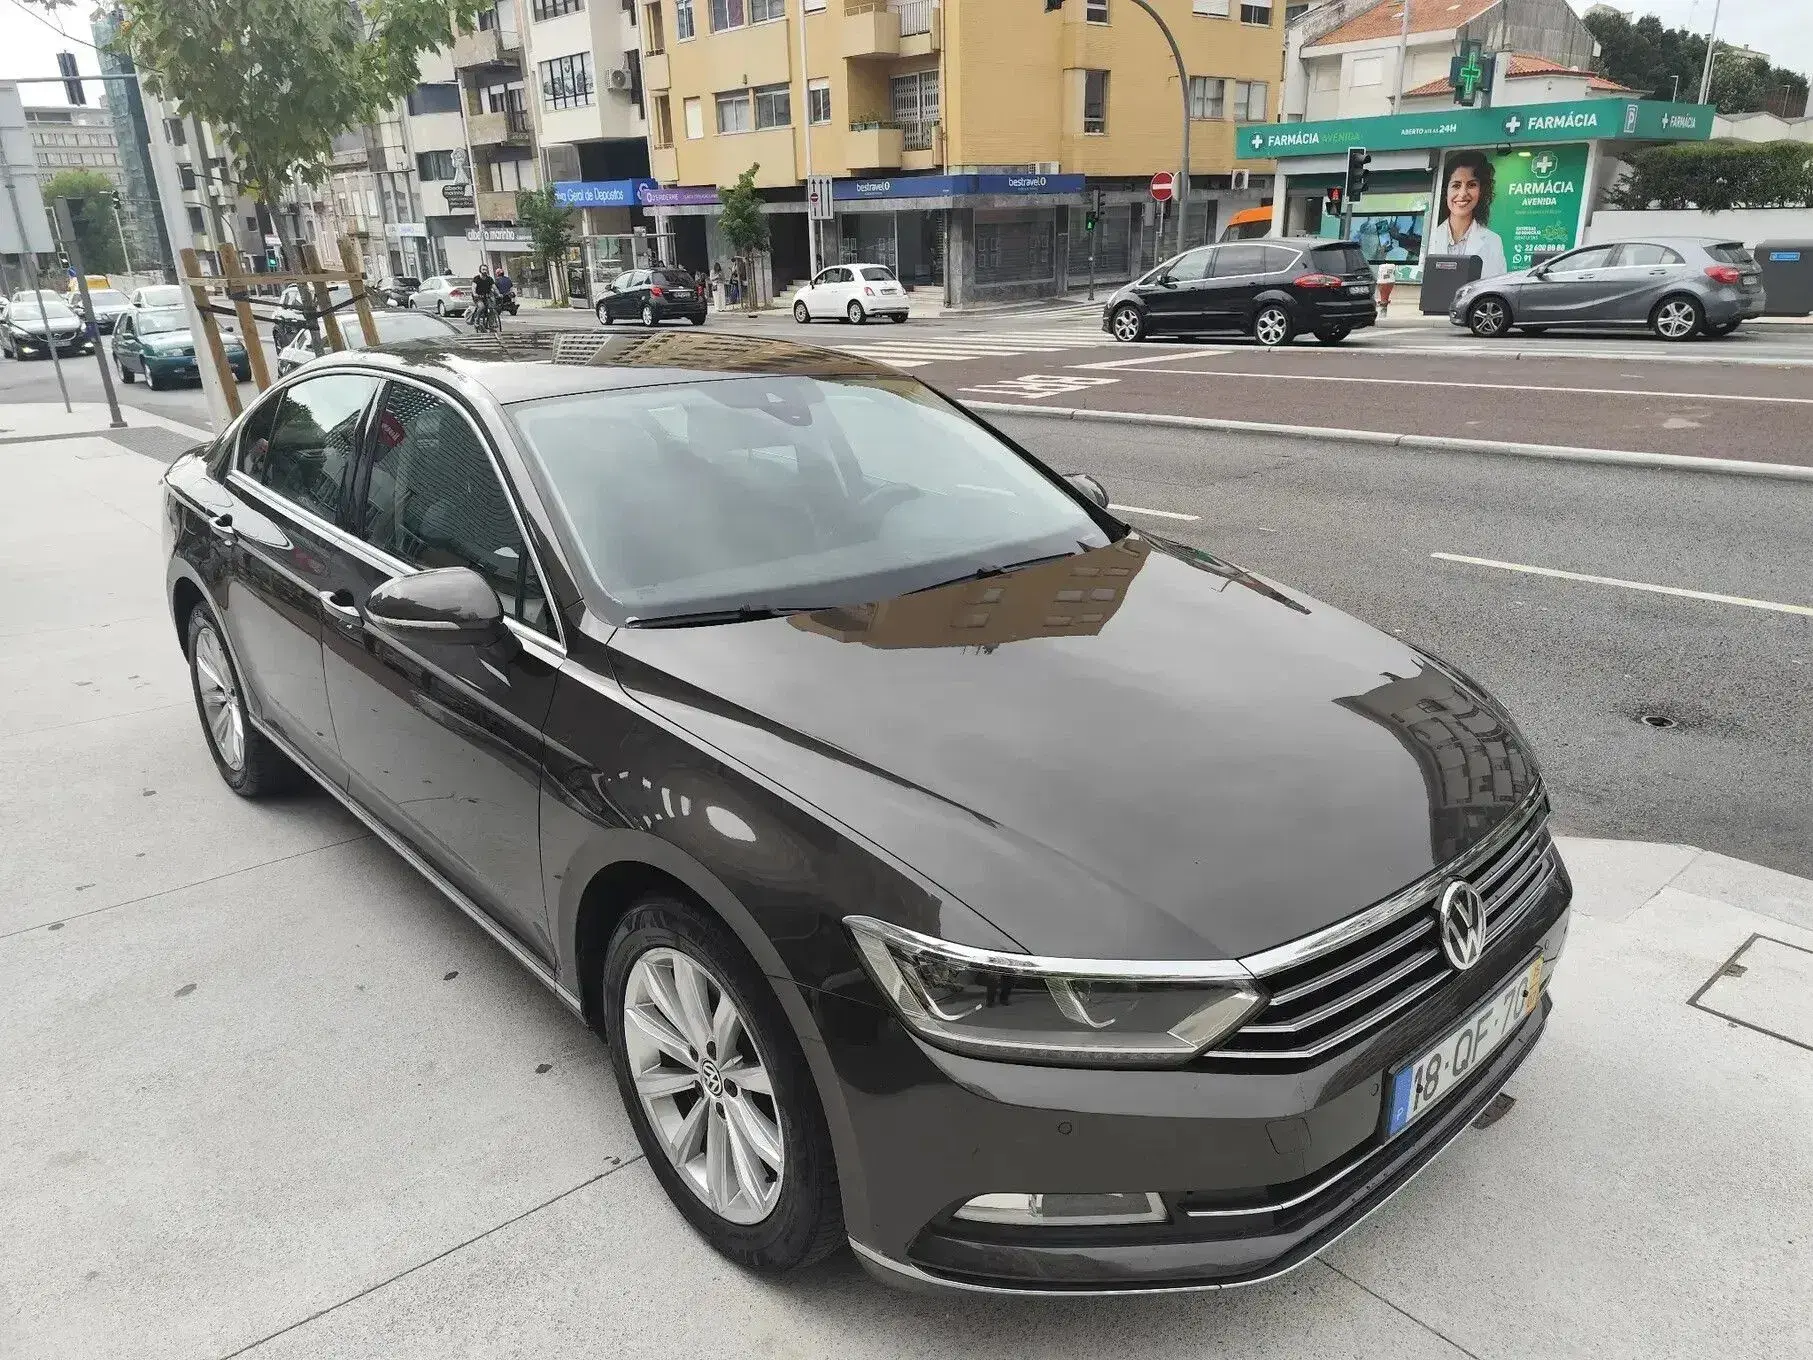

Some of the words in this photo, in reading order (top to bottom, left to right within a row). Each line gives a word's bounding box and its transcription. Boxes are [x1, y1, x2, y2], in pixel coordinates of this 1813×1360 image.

[1527, 111, 1598, 130] FARMÁCIA
[1669, 113, 1697, 129] FARMÁCIA
[1401, 127, 1424, 136] ABERTO
[1439, 123, 1457, 134] 24H
[1267, 132, 1320, 147] FARMÁCIA
[1508, 180, 1575, 195] FARMÁCIA
[567, 188, 585, 202] Geral
[585, 189, 593, 201] de
[1521, 197, 1557, 206] AVENIDA
[1523, 254, 1532, 263] 91
